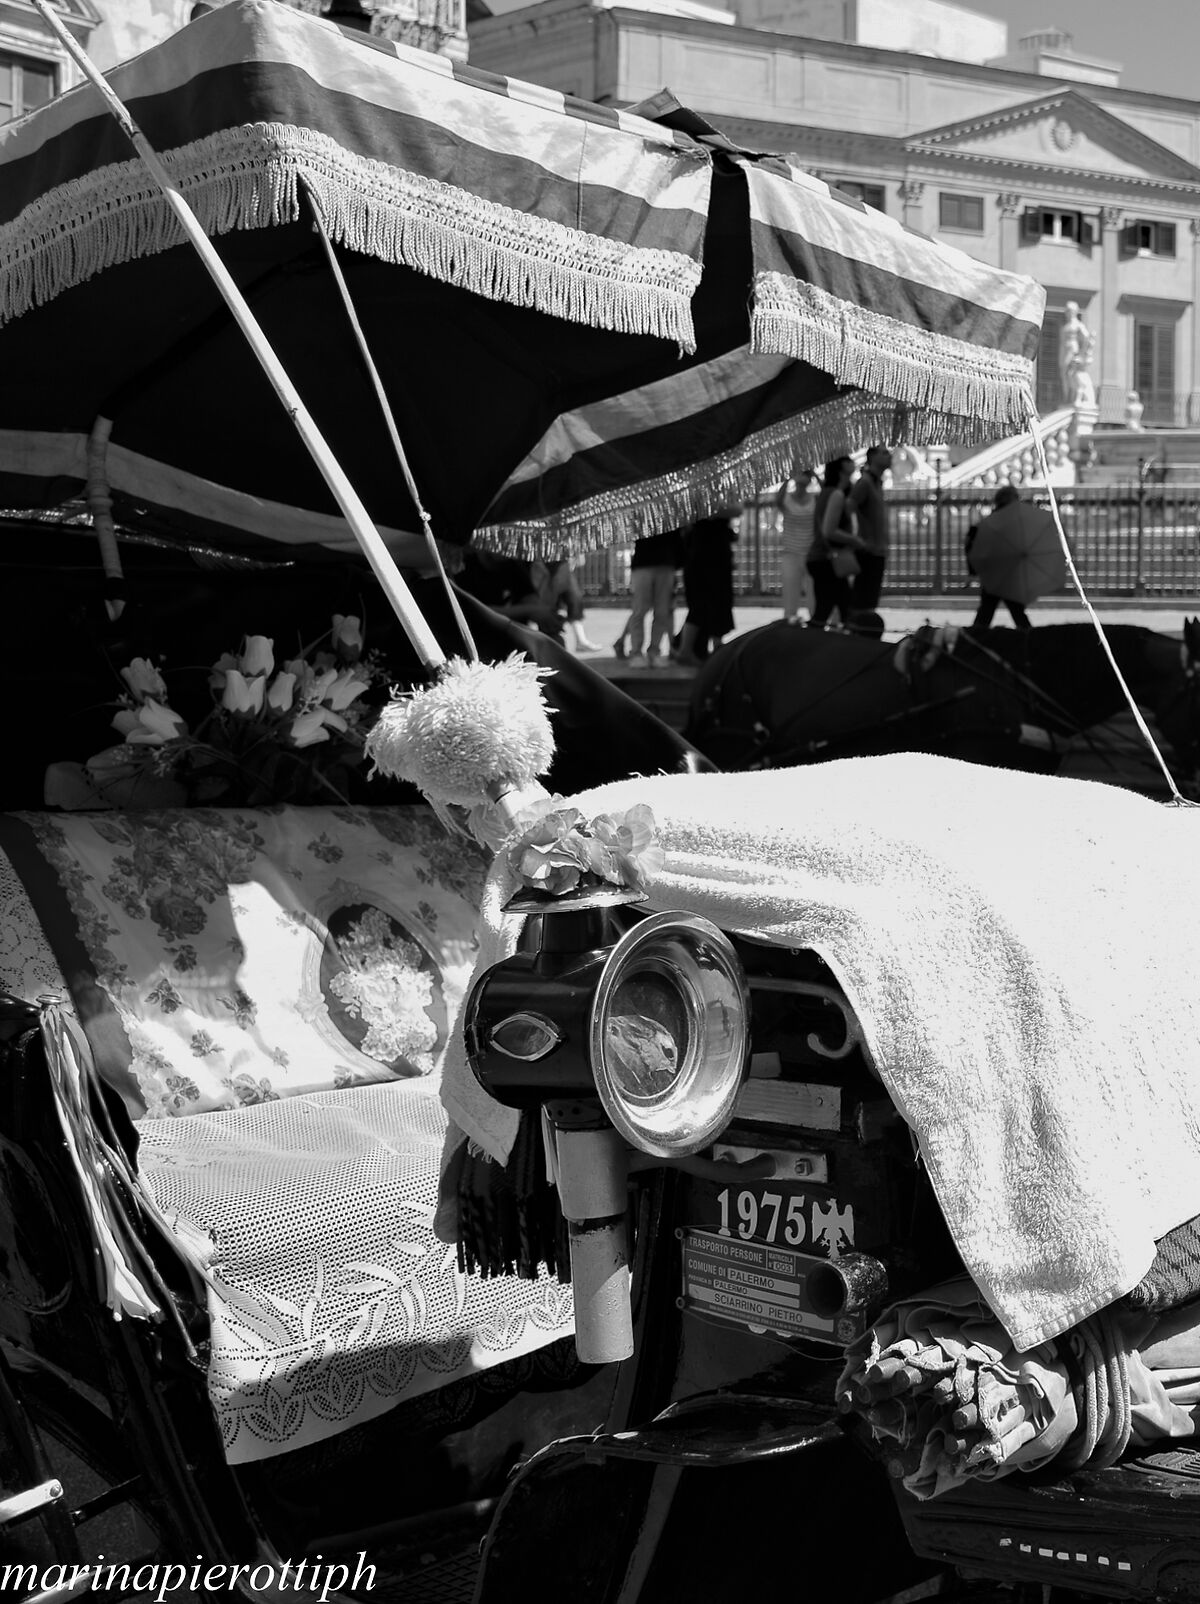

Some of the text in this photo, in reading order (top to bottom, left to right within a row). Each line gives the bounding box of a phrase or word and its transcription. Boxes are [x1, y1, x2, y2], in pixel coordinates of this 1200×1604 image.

[717, 1188, 806, 1245] 1975
[688, 1236, 764, 1263] TRASPORTO PERSONE
[688, 1258, 775, 1289] COMUNE DI PALERMO
[715, 1280, 748, 1295] PALERMO
[714, 1293, 763, 1314] SCIARRINO
[769, 1307, 803, 1324] PIETRO
